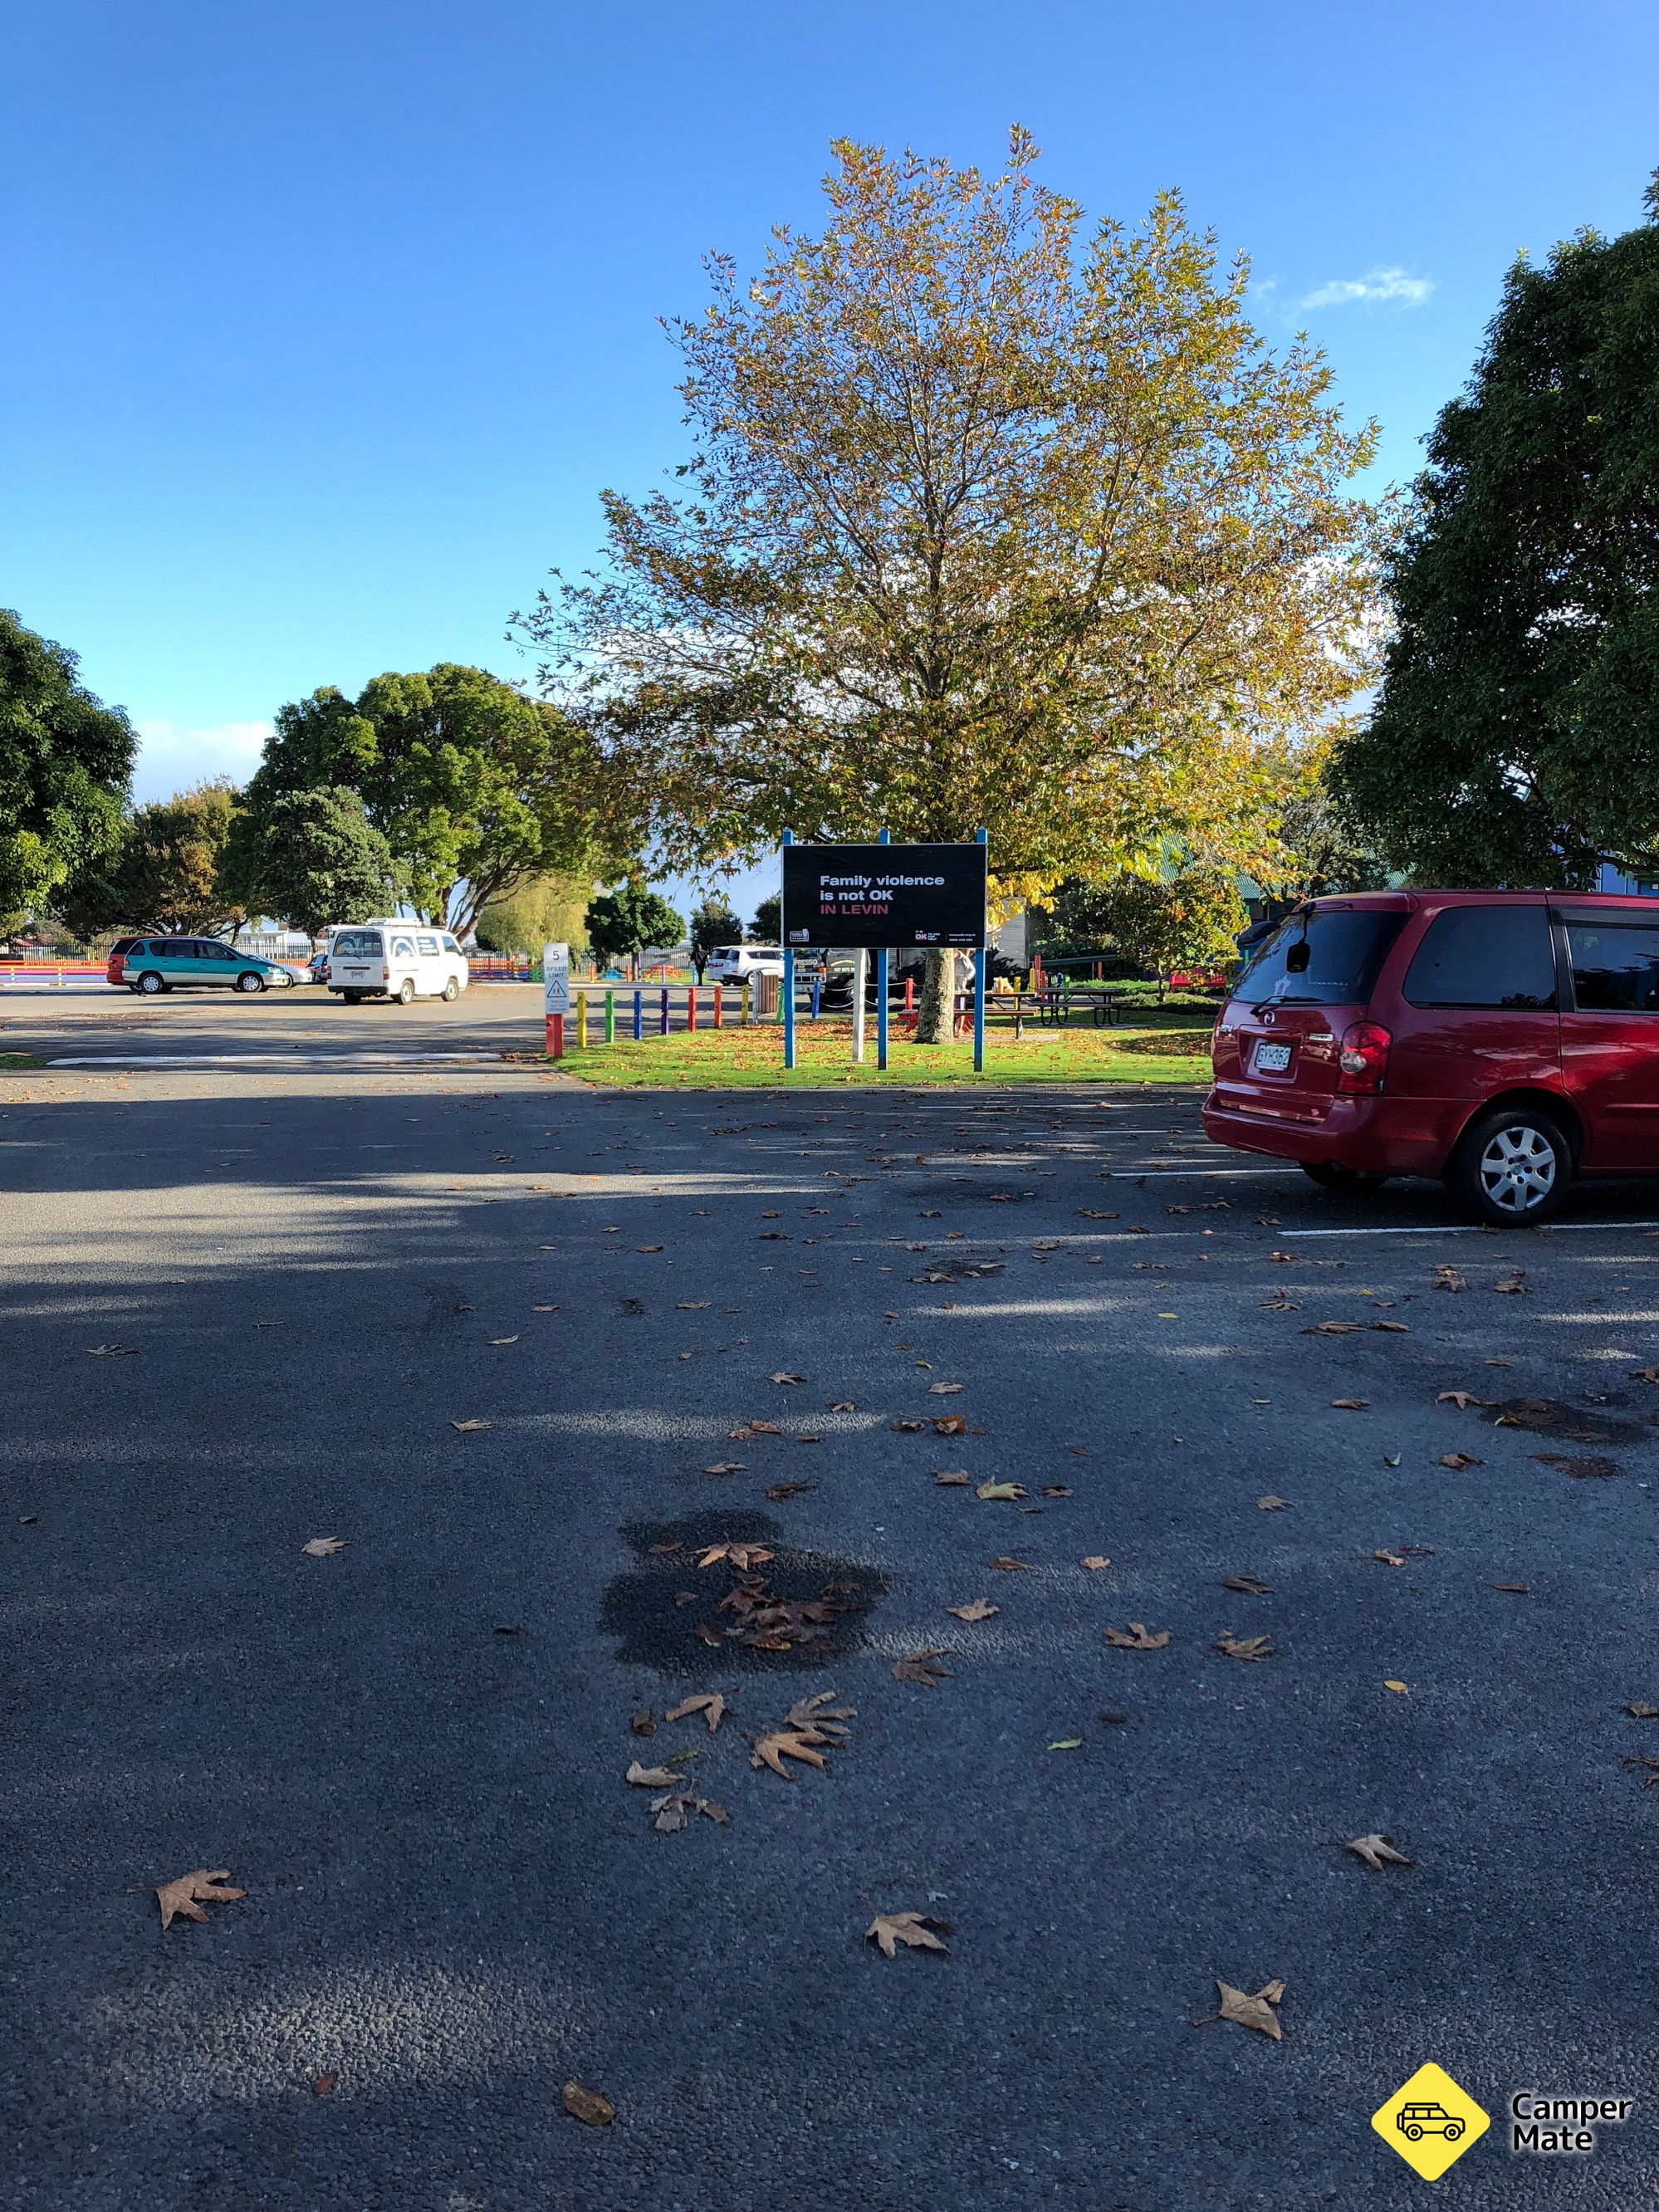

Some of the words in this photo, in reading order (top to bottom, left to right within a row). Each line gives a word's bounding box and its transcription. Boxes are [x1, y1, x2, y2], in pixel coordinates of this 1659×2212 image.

[820, 875, 872, 888] Family
[876, 874, 945, 886] violence
[820, 889, 834, 901] is
[839, 889, 865, 901] not
[869, 889, 893, 901] OK
[820, 904, 837, 915] IN
[842, 904, 888, 915] LEVIN
[553, 951, 560, 961] 5
[1258, 1047, 1290, 1066] GYH362
